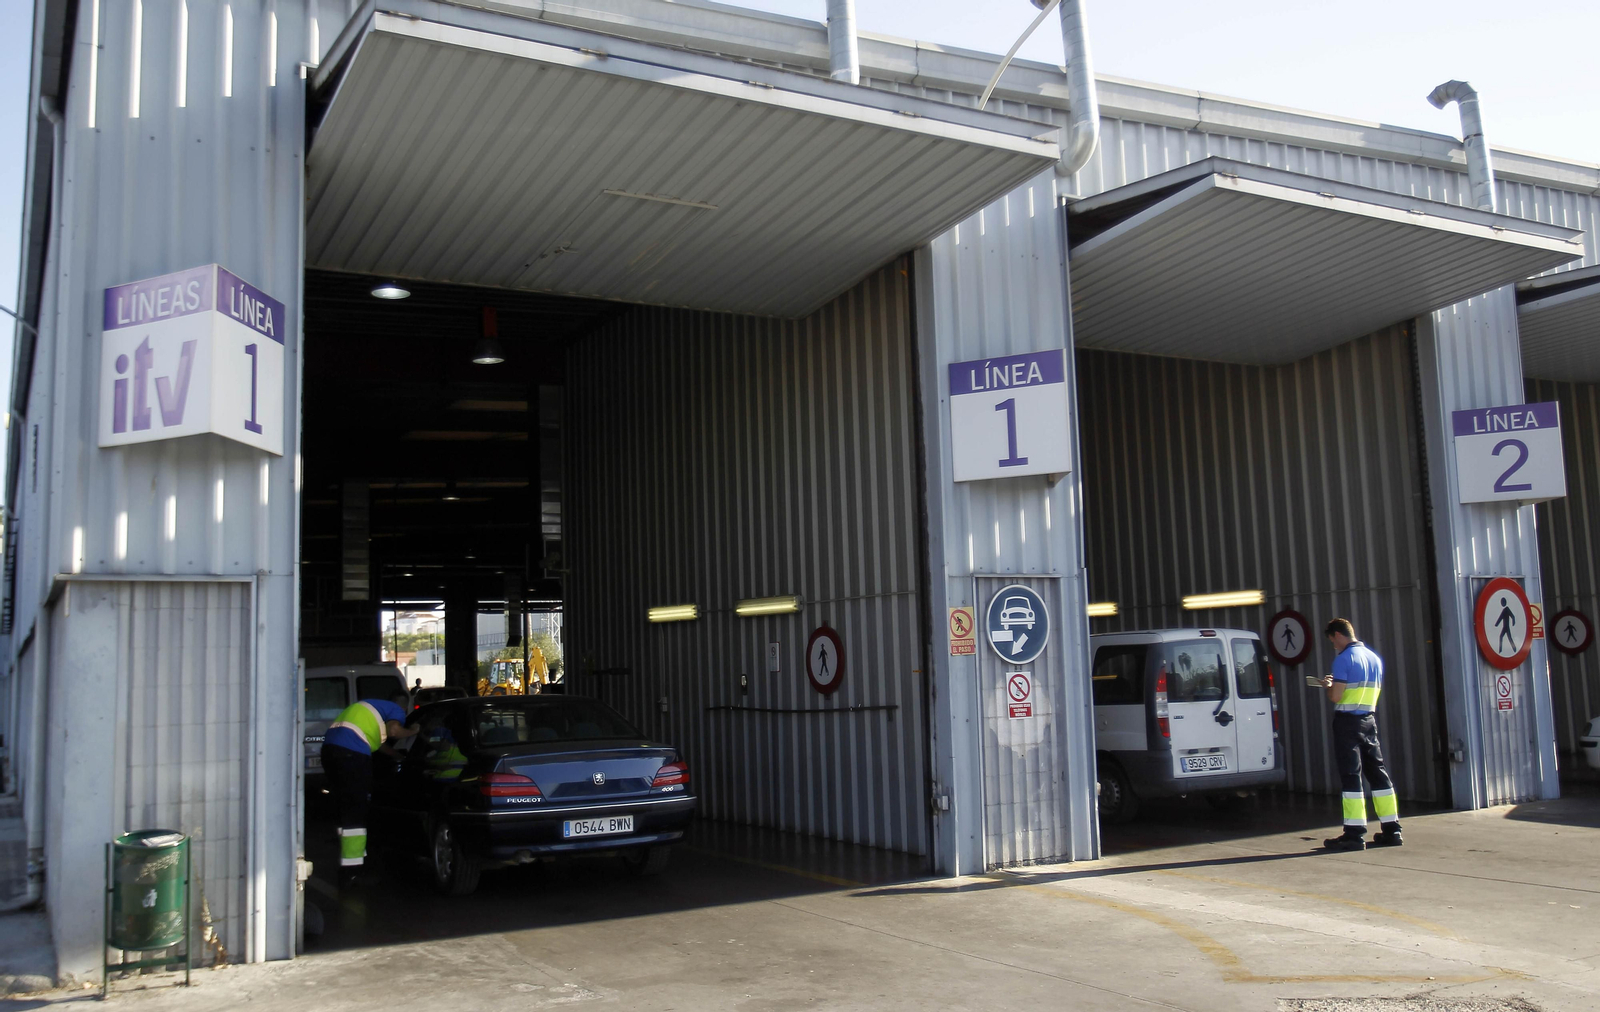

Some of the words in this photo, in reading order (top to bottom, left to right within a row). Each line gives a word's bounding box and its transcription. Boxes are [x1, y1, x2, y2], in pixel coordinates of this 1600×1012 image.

[117, 280, 200, 325] LÍNEAS
[230, 284, 275, 336] LÍNEA
[244, 343, 263, 435] 1
[970, 361, 1043, 391] LÍNEA
[995, 398, 1028, 467] 1
[1473, 410, 1539, 433] LÍNEA
[1491, 439, 1532, 493] 2
[1188, 758, 1207, 769] 9529
[1209, 756, 1222, 767] CRV
[574, 820, 604, 835] 0544
[609, 817, 631, 832] BWN
